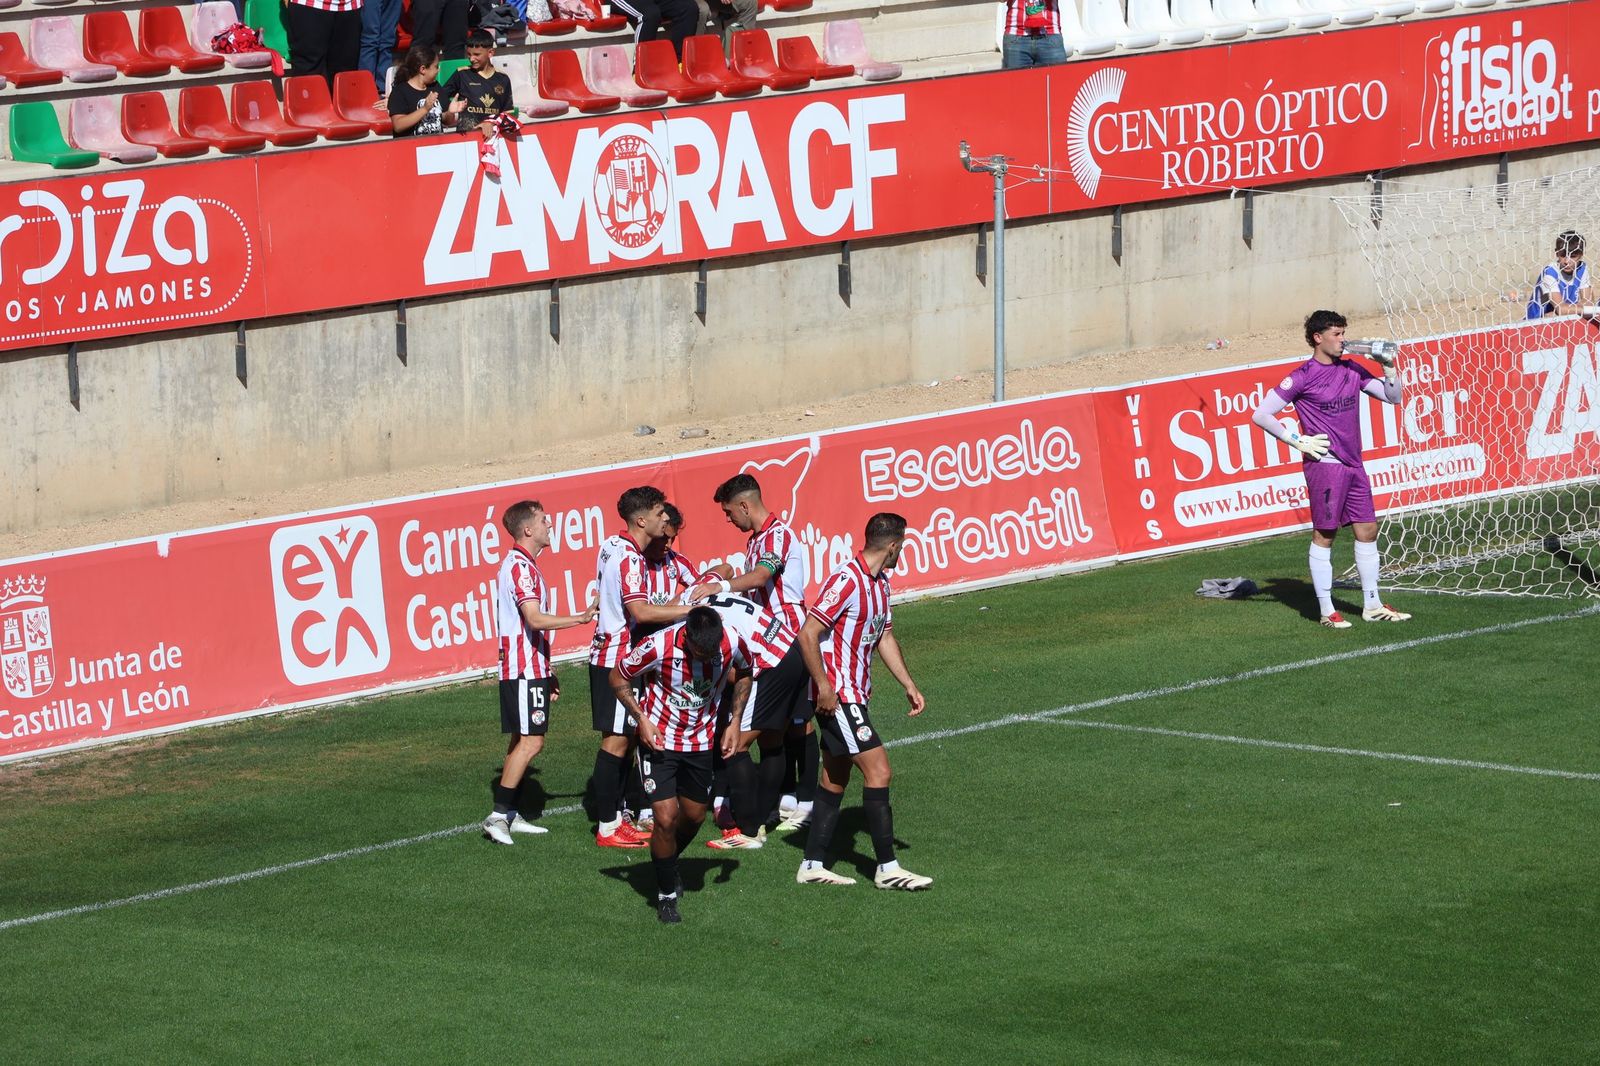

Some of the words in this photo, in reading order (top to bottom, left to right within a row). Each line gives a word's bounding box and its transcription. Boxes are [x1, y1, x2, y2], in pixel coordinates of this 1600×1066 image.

[1451, 20, 1557, 105] fisio
[1093, 98, 1245, 155] CENTRO
[1255, 79, 1388, 135] ÓPTICO
[1452, 74, 1574, 136] readapt
[1161, 132, 1324, 189] ROBERTO
[1452, 127, 1538, 147] POLICLÍNICA
[416, 110, 787, 286] ZAMORA
[788, 93, 906, 237] CF
[607, 224, 648, 248] ZAMORA
[53, 294, 66, 316] Y
[77, 276, 212, 314] JAMONES
[1402, 355, 1442, 387] del
[1522, 341, 1600, 460] ZA
[860, 418, 1081, 503] Escuela
[399, 505, 500, 577] Carné
[890, 487, 1094, 578] nfantil
[406, 579, 498, 651] Castil
[65, 657, 142, 687] Junta
[149, 641, 182, 672] de
[0, 698, 92, 740] Castilla
[98, 697, 113, 731] y
[122, 681, 189, 717] León
[529, 686, 545, 708] 15
[850, 703, 864, 725] 9
